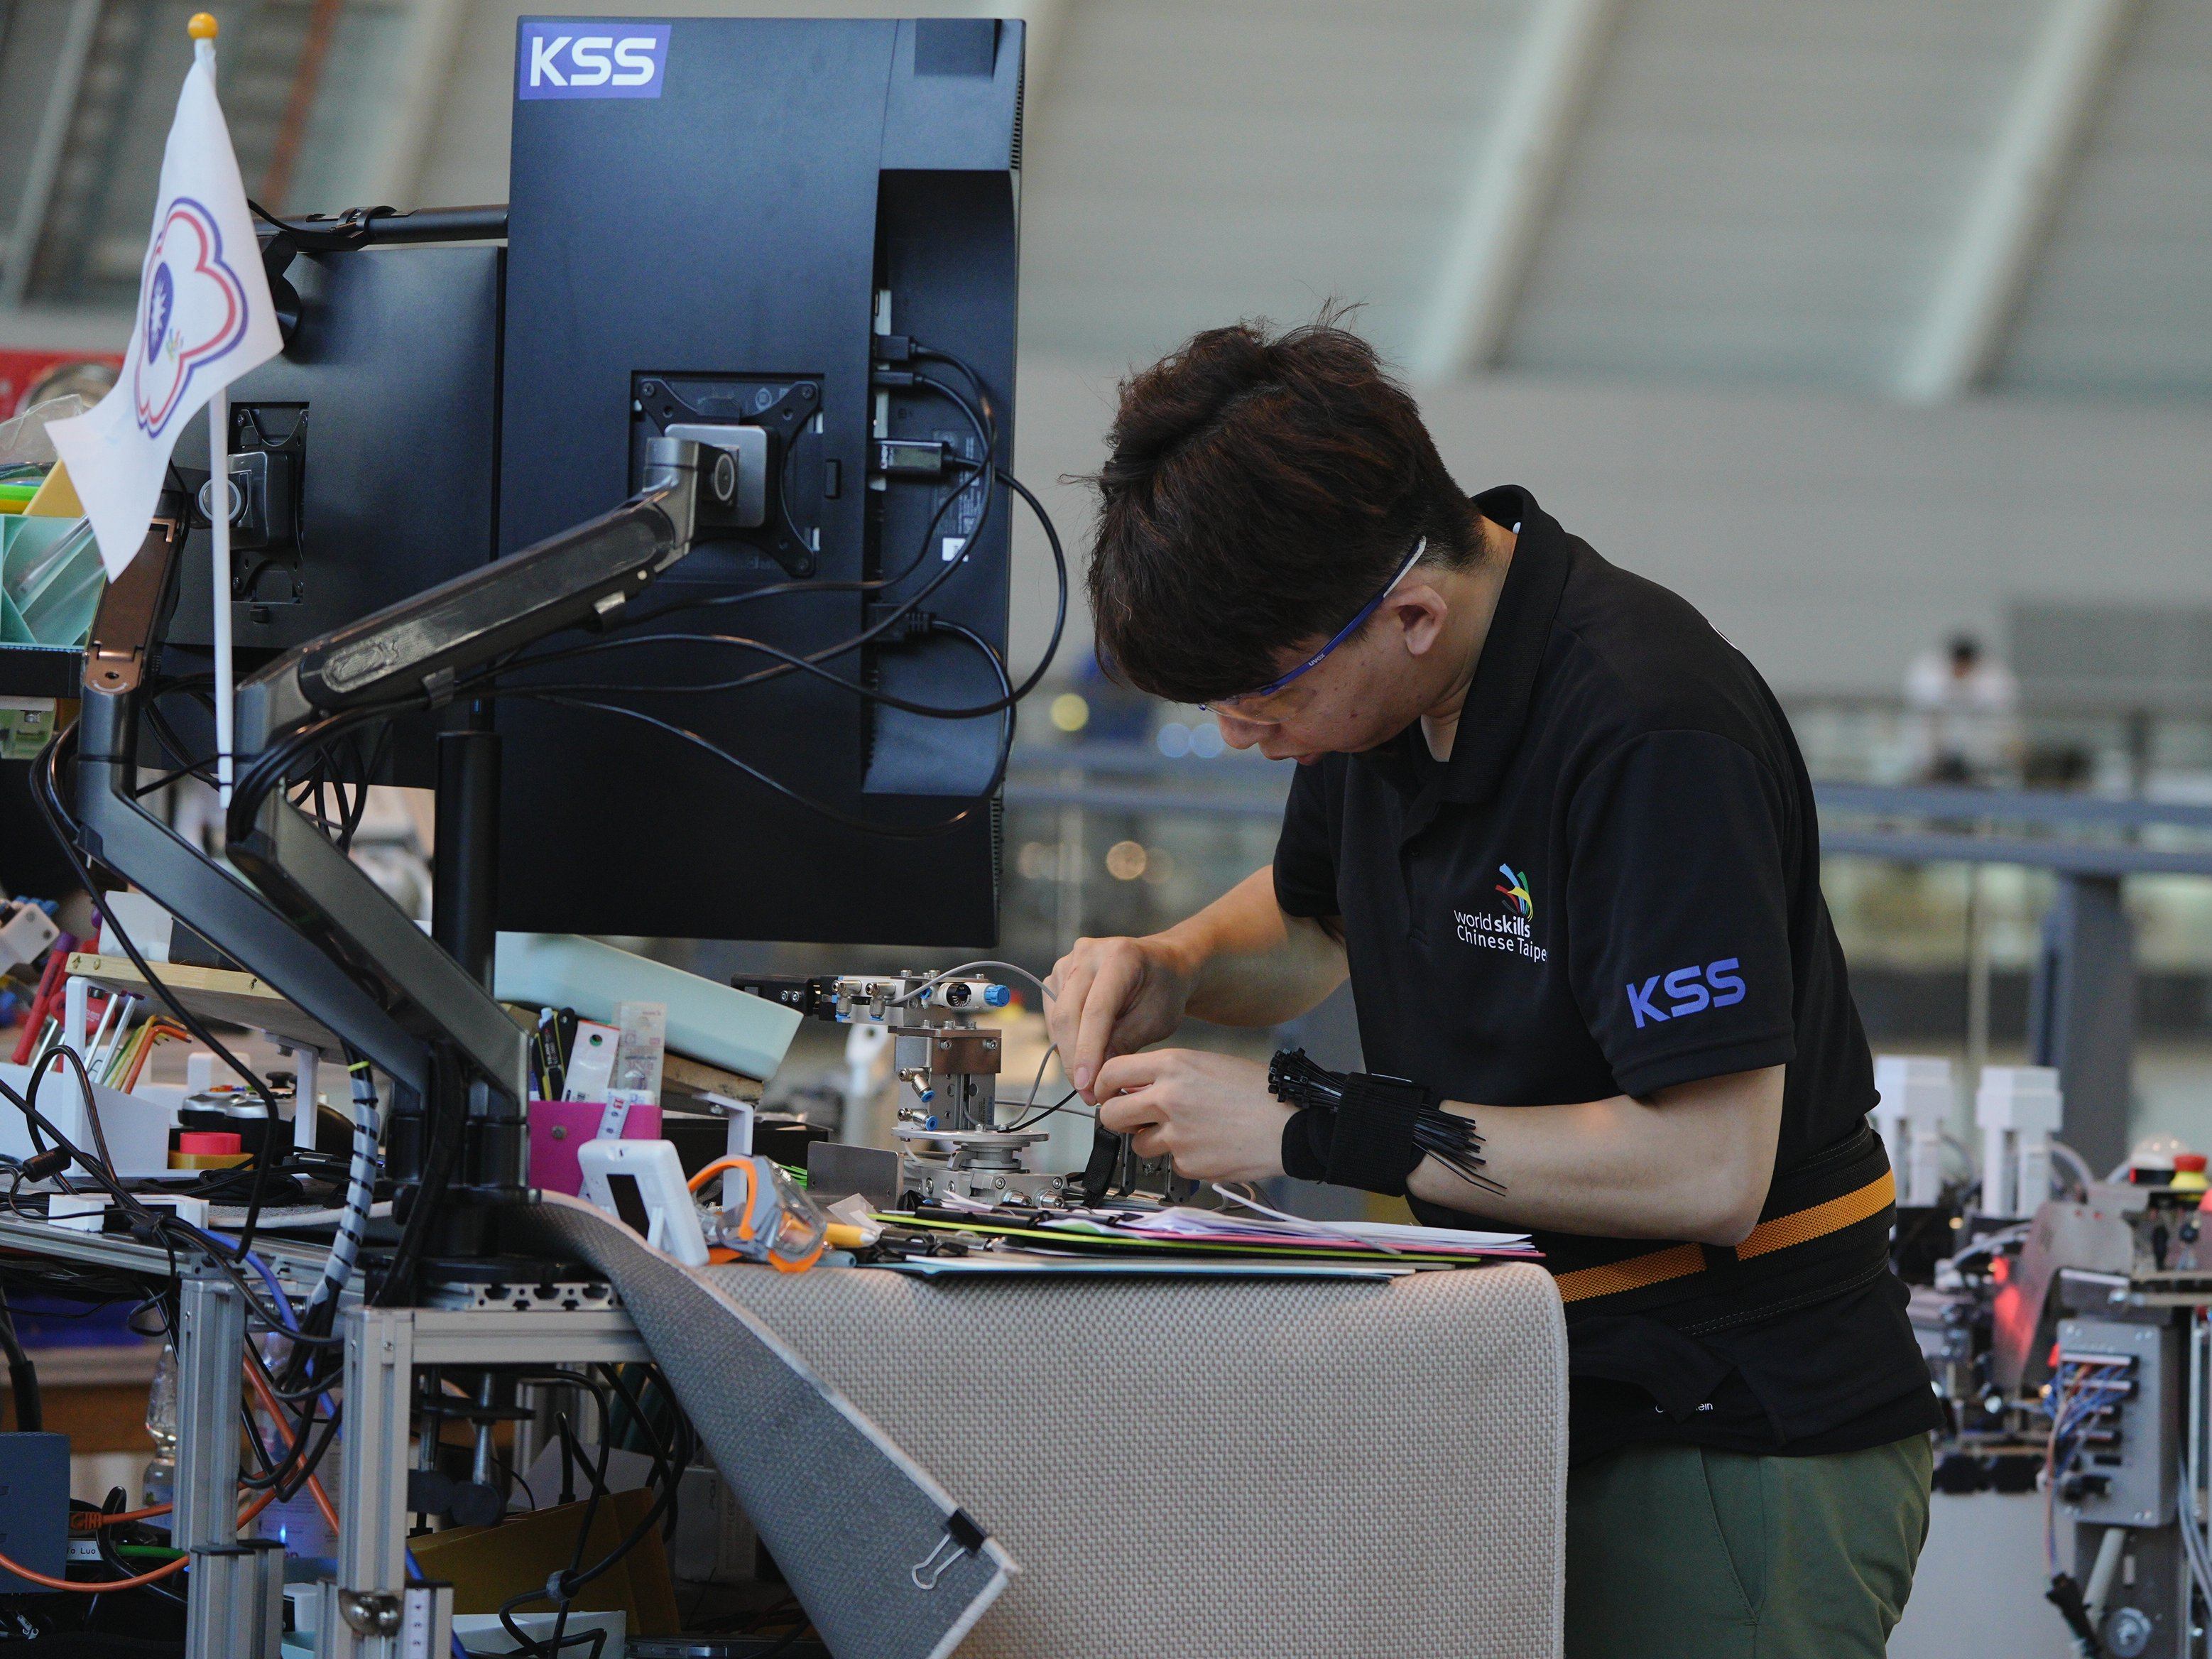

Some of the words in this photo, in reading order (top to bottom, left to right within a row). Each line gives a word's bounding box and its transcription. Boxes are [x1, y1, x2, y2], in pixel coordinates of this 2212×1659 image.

[530, 37, 656, 87] KSS
[1308, 653, 1325, 666] uvex
[1457, 925, 1514, 952] Chinese
[1626, 957, 1746, 1028] KSS
